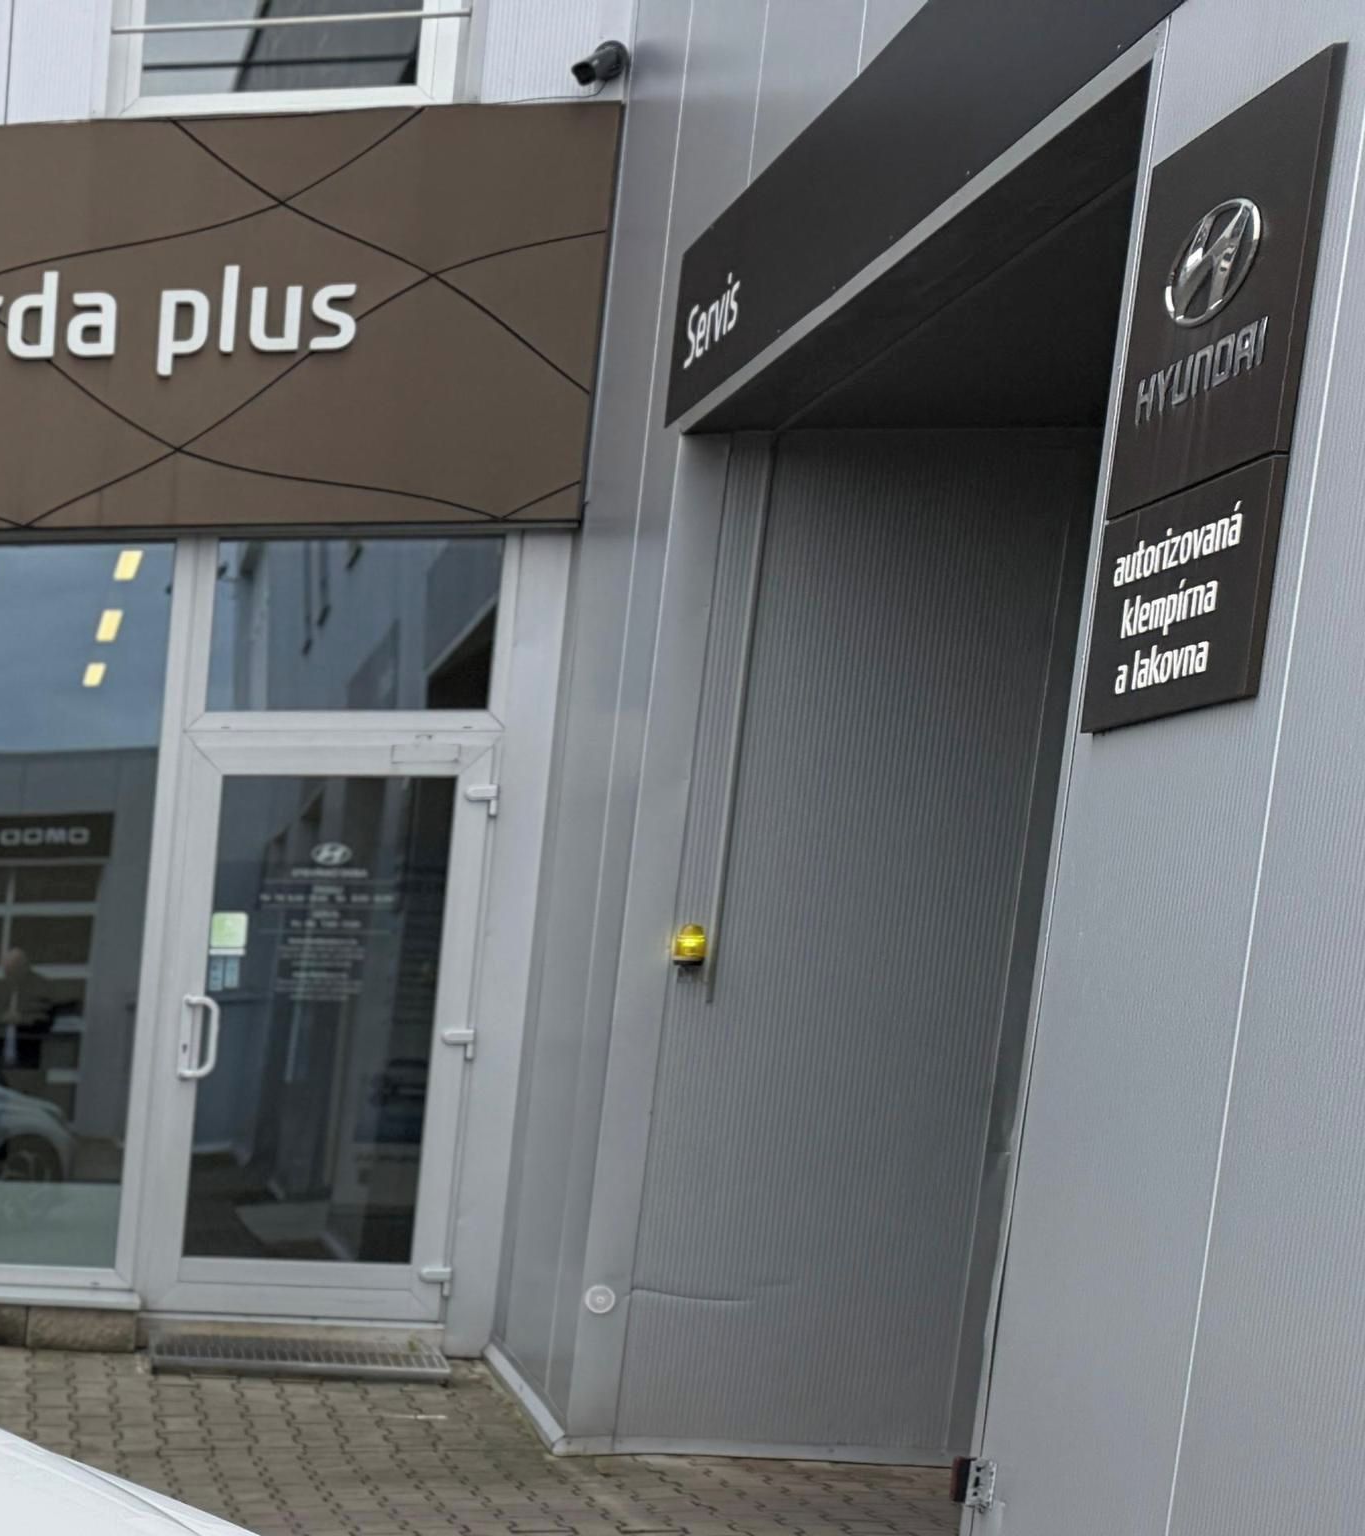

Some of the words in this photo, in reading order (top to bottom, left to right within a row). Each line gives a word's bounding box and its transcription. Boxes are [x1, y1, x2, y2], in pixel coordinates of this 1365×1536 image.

[156, 264, 358, 377] plus
[683, 271, 741, 370] Servis
[1134, 315, 1269, 426] HYUNDAI
[1113, 500, 1243, 588] autorizovaná
[1120, 577, 1219, 640] klempírna
[1114, 662, 1128, 695] a
[1131, 640, 1210, 692] lakovna
